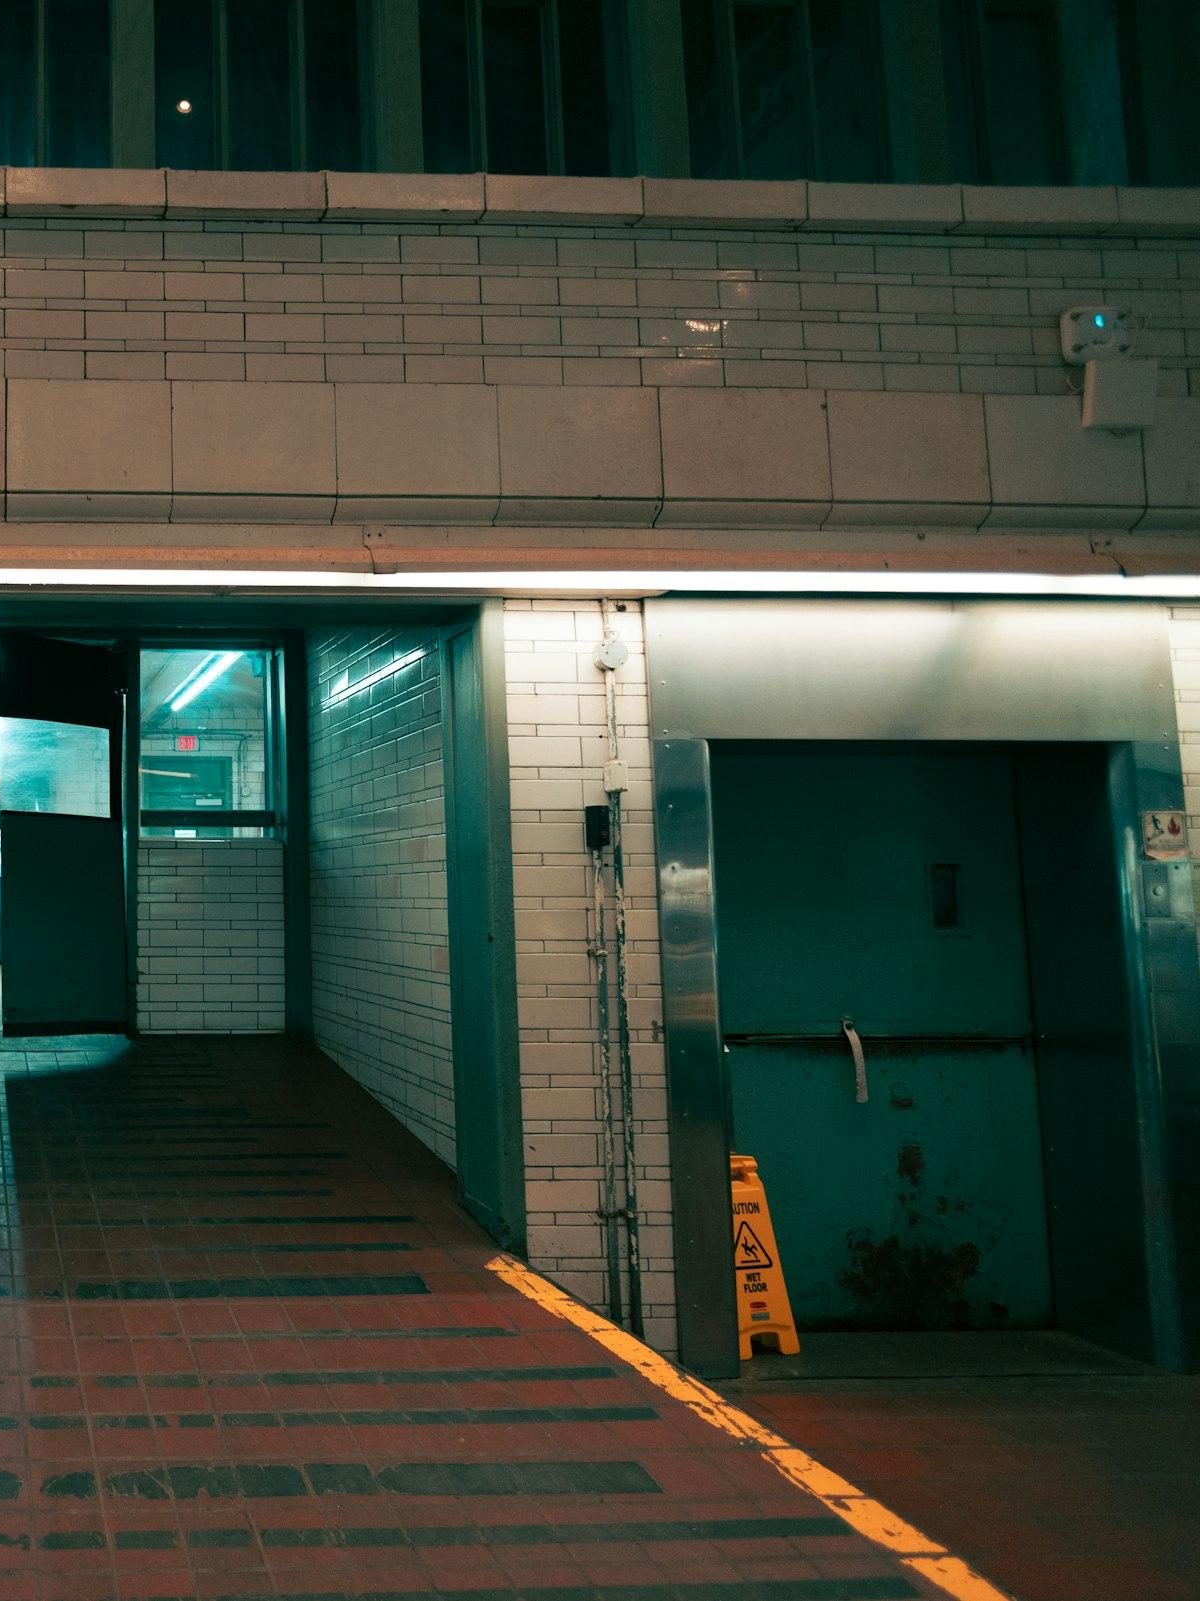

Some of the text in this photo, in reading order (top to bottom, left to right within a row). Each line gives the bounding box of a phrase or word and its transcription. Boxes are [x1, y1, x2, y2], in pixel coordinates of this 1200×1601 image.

[179, 736, 196, 750] EXIT
[732, 1202, 760, 1215] UTION
[745, 1272, 761, 1282] WET
[743, 1282, 768, 1293] FLOOR
